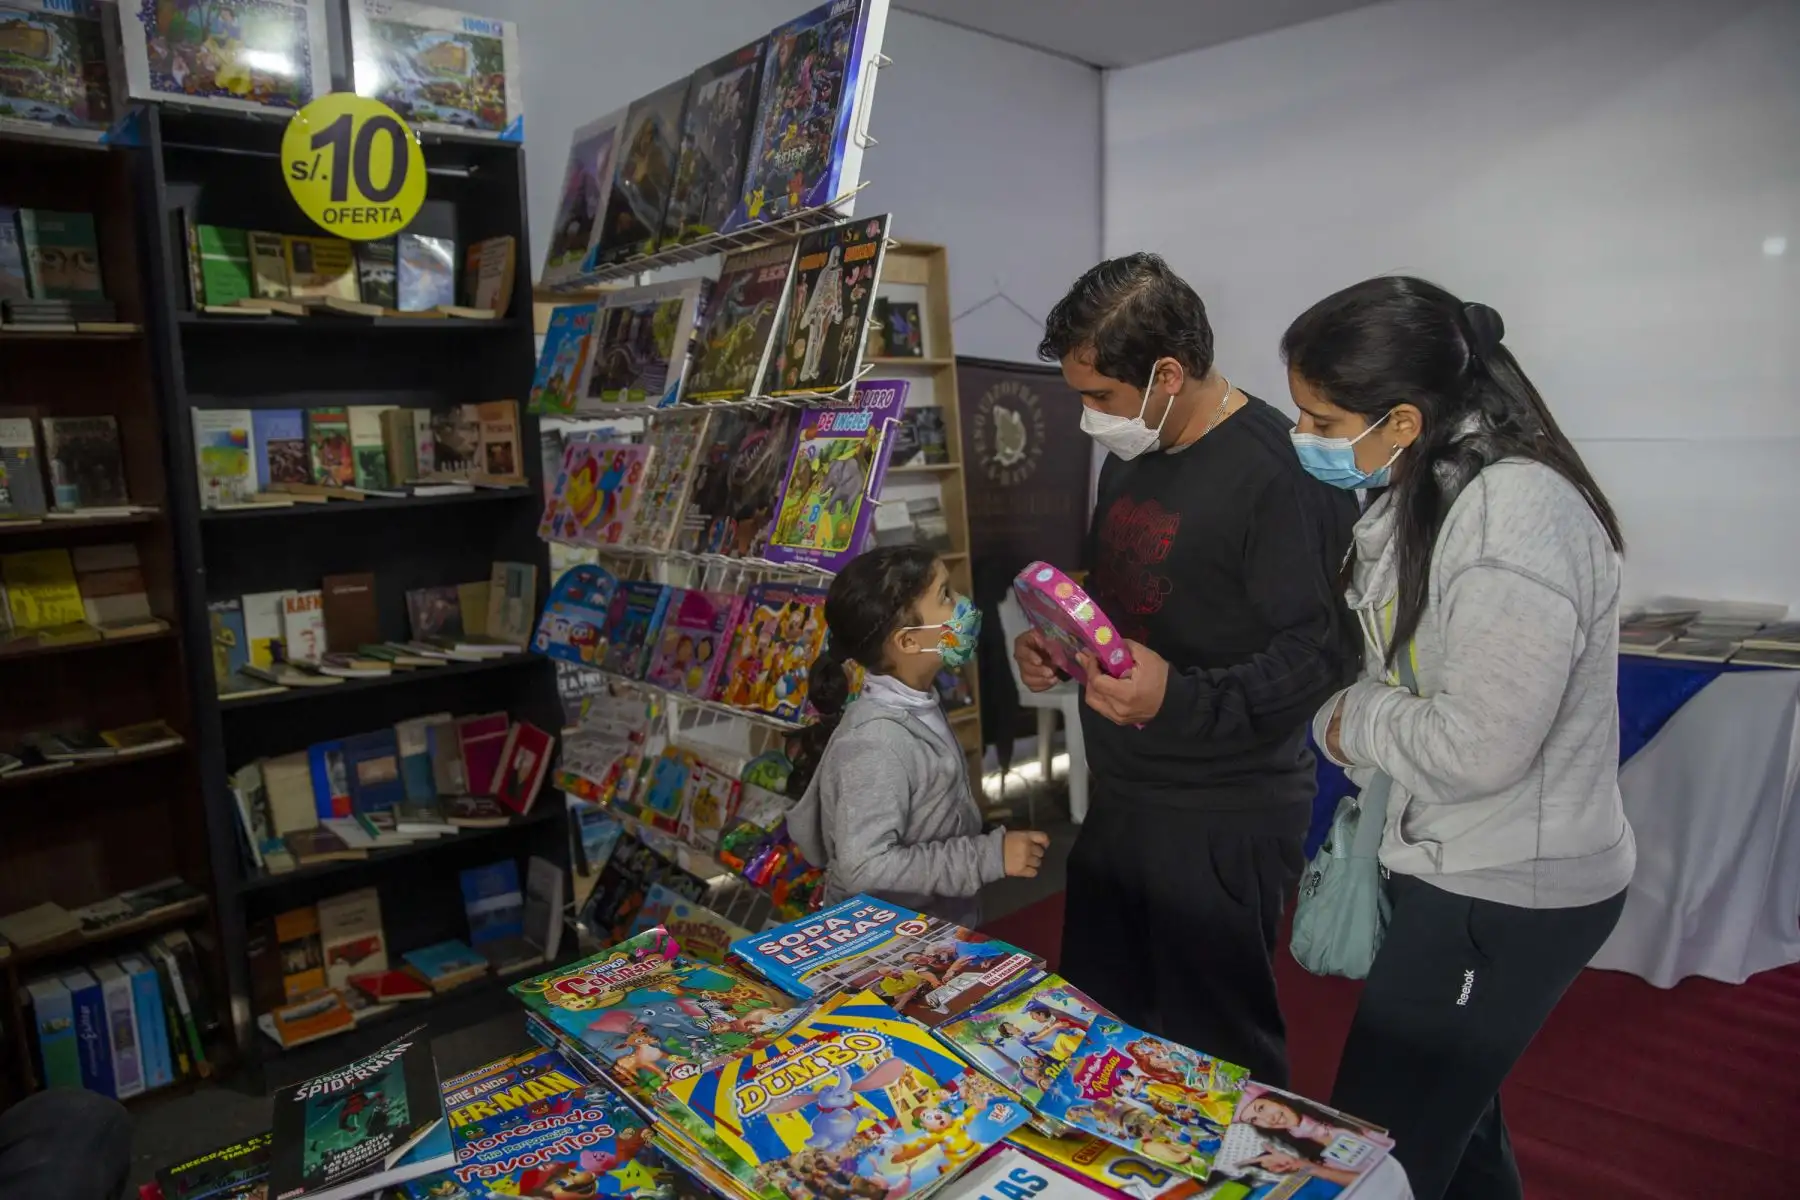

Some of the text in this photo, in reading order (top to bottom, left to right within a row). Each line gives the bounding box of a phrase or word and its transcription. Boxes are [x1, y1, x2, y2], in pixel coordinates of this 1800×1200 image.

[311, 114, 408, 202] 10
[323, 207, 403, 224] OFERTA
[818, 412, 835, 431] DE
[758, 905, 878, 956] SOPA DE
[775, 909, 898, 965] LETRAS
[901, 921, 924, 936] 5
[1456, 969, 1475, 1006] Reebok
[292, 1041, 414, 1103] SPIDERMAN
[444, 1077, 509, 1108] OREANDO
[736, 1034, 882, 1115] DUMBO
[458, 1108, 604, 1161] oloreando
[978, 1167, 1049, 1200] AS
